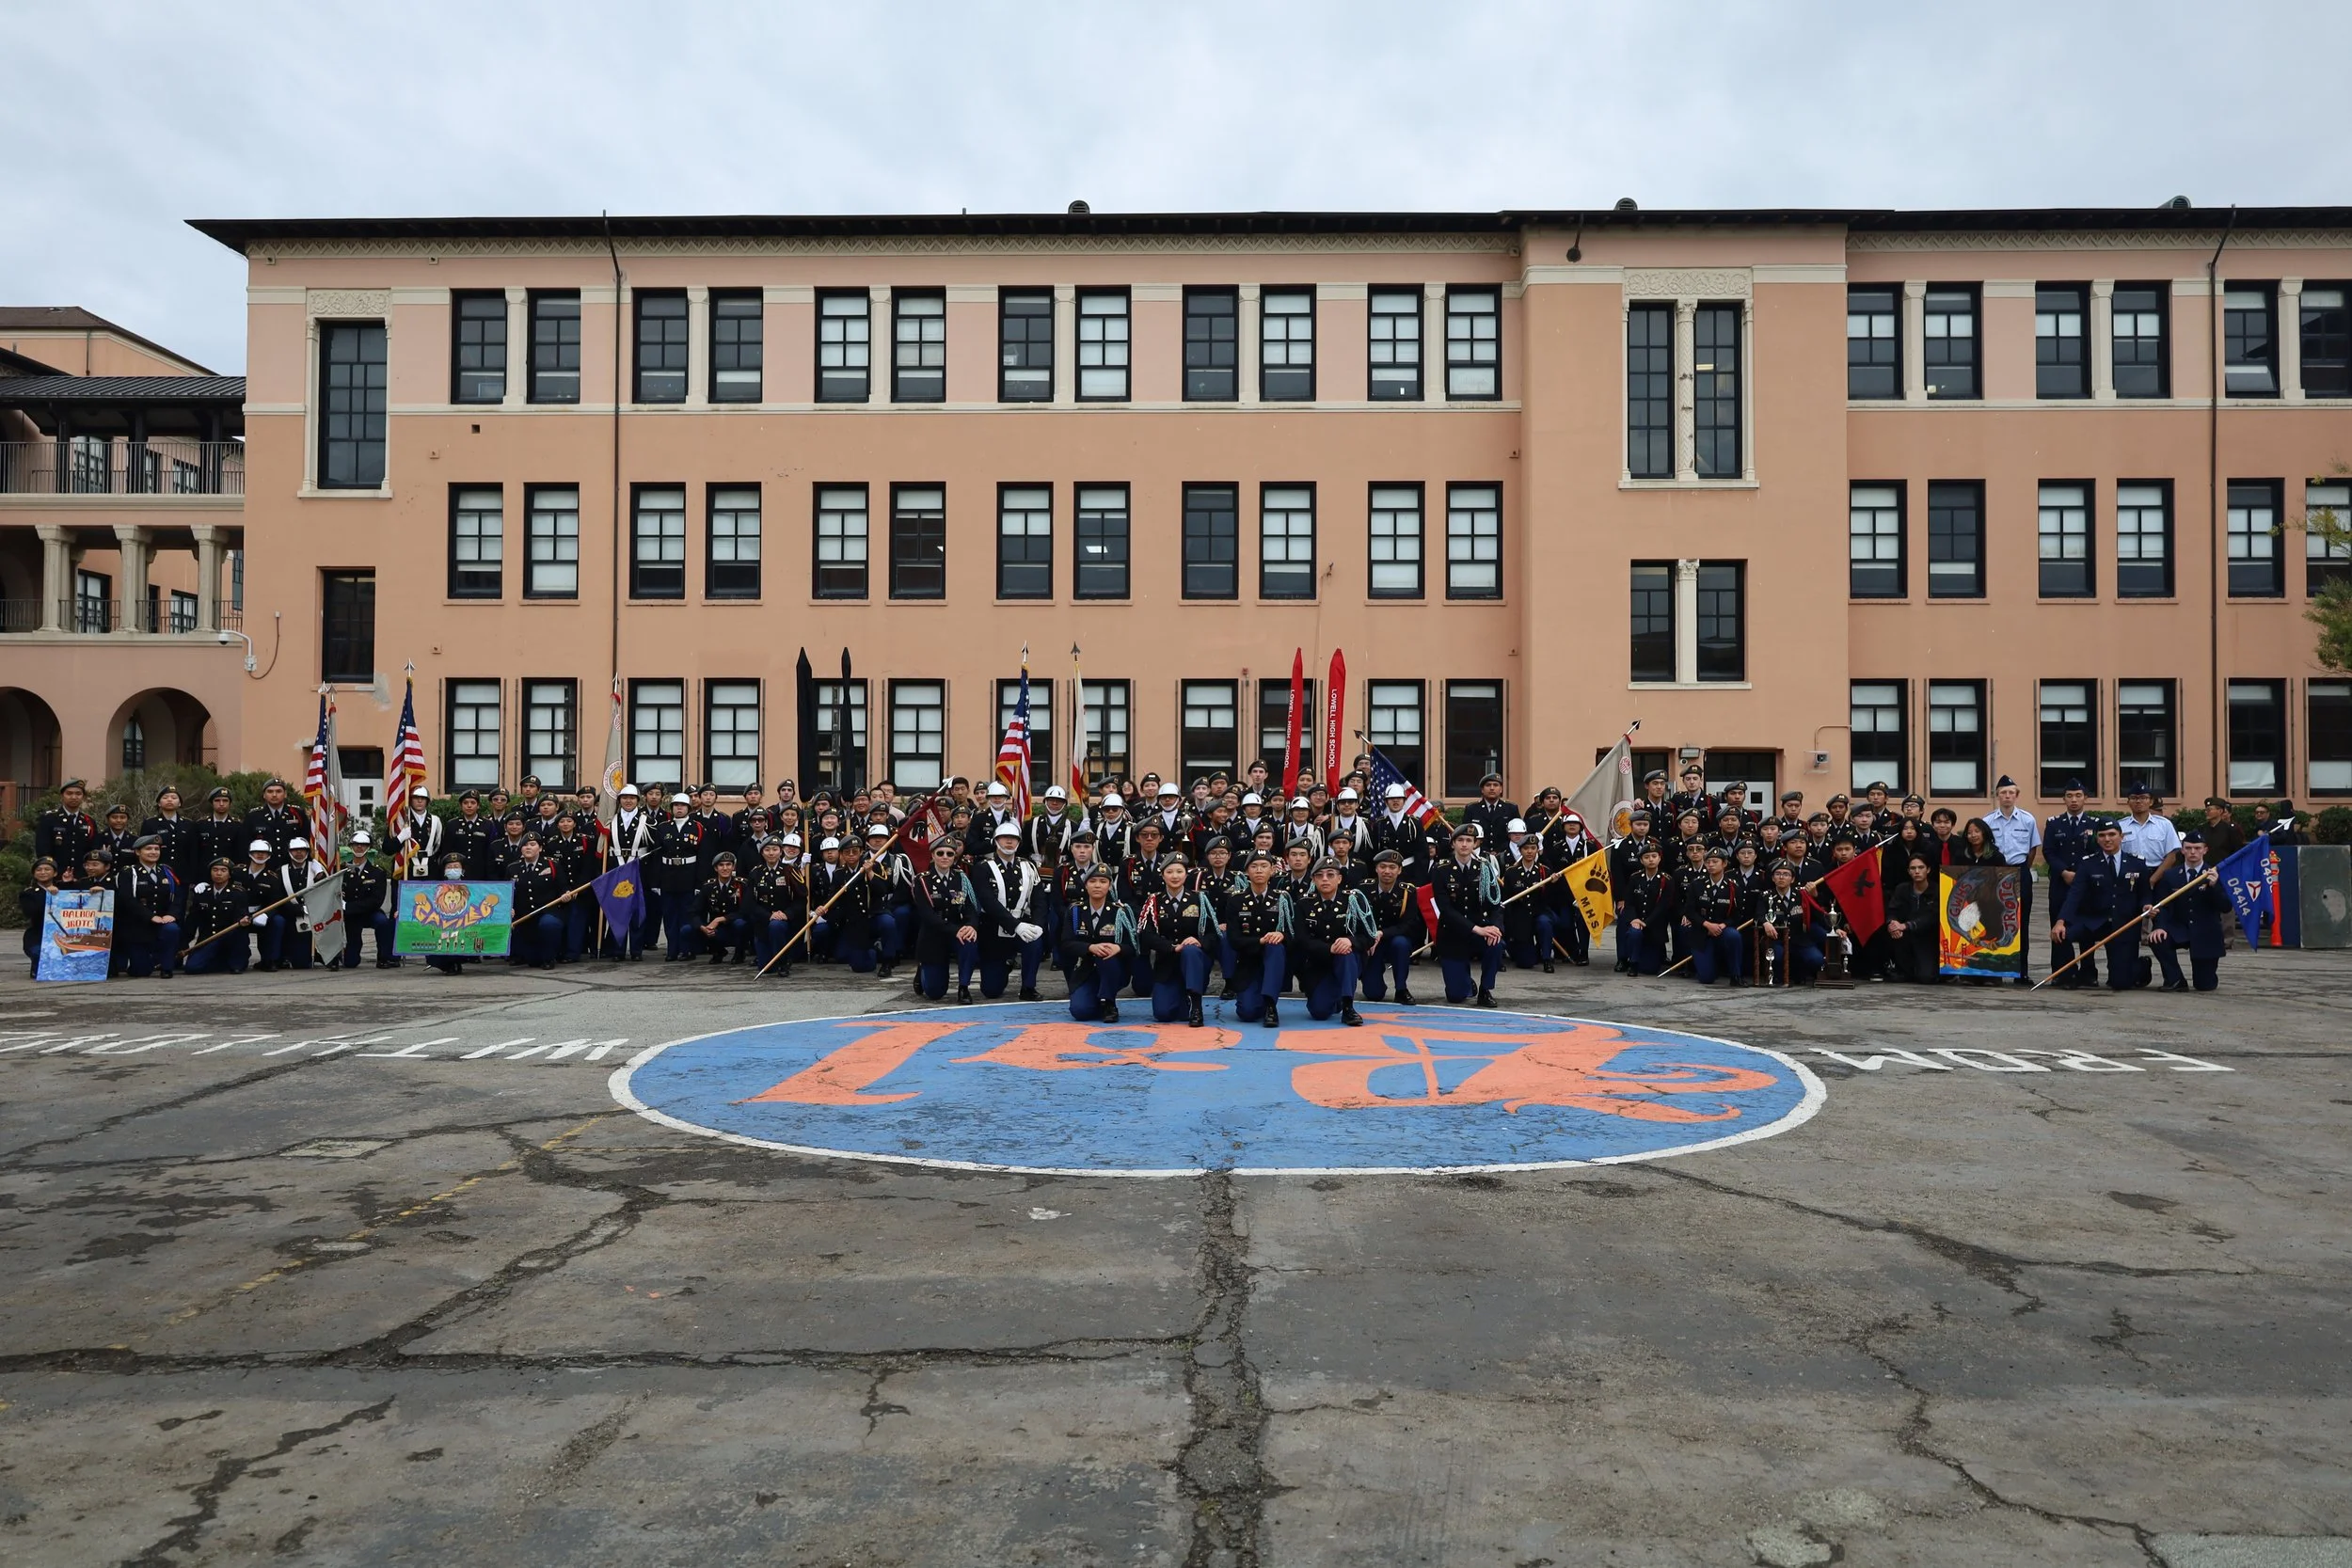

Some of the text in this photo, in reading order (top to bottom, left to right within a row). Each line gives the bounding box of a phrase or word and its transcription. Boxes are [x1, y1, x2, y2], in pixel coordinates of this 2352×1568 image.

[1329, 689, 1338, 719] LOWELL
[1949, 884, 1973, 918] GWHS
[1998, 880, 2016, 933] JROTC
[2227, 877, 2251, 917] 04414
[62, 910, 96, 919] BALBOA
[65, 920, 94, 928] JROTC
[262, 1035, 628, 1060] WITH
[1808, 1048, 2235, 1071] FROM
